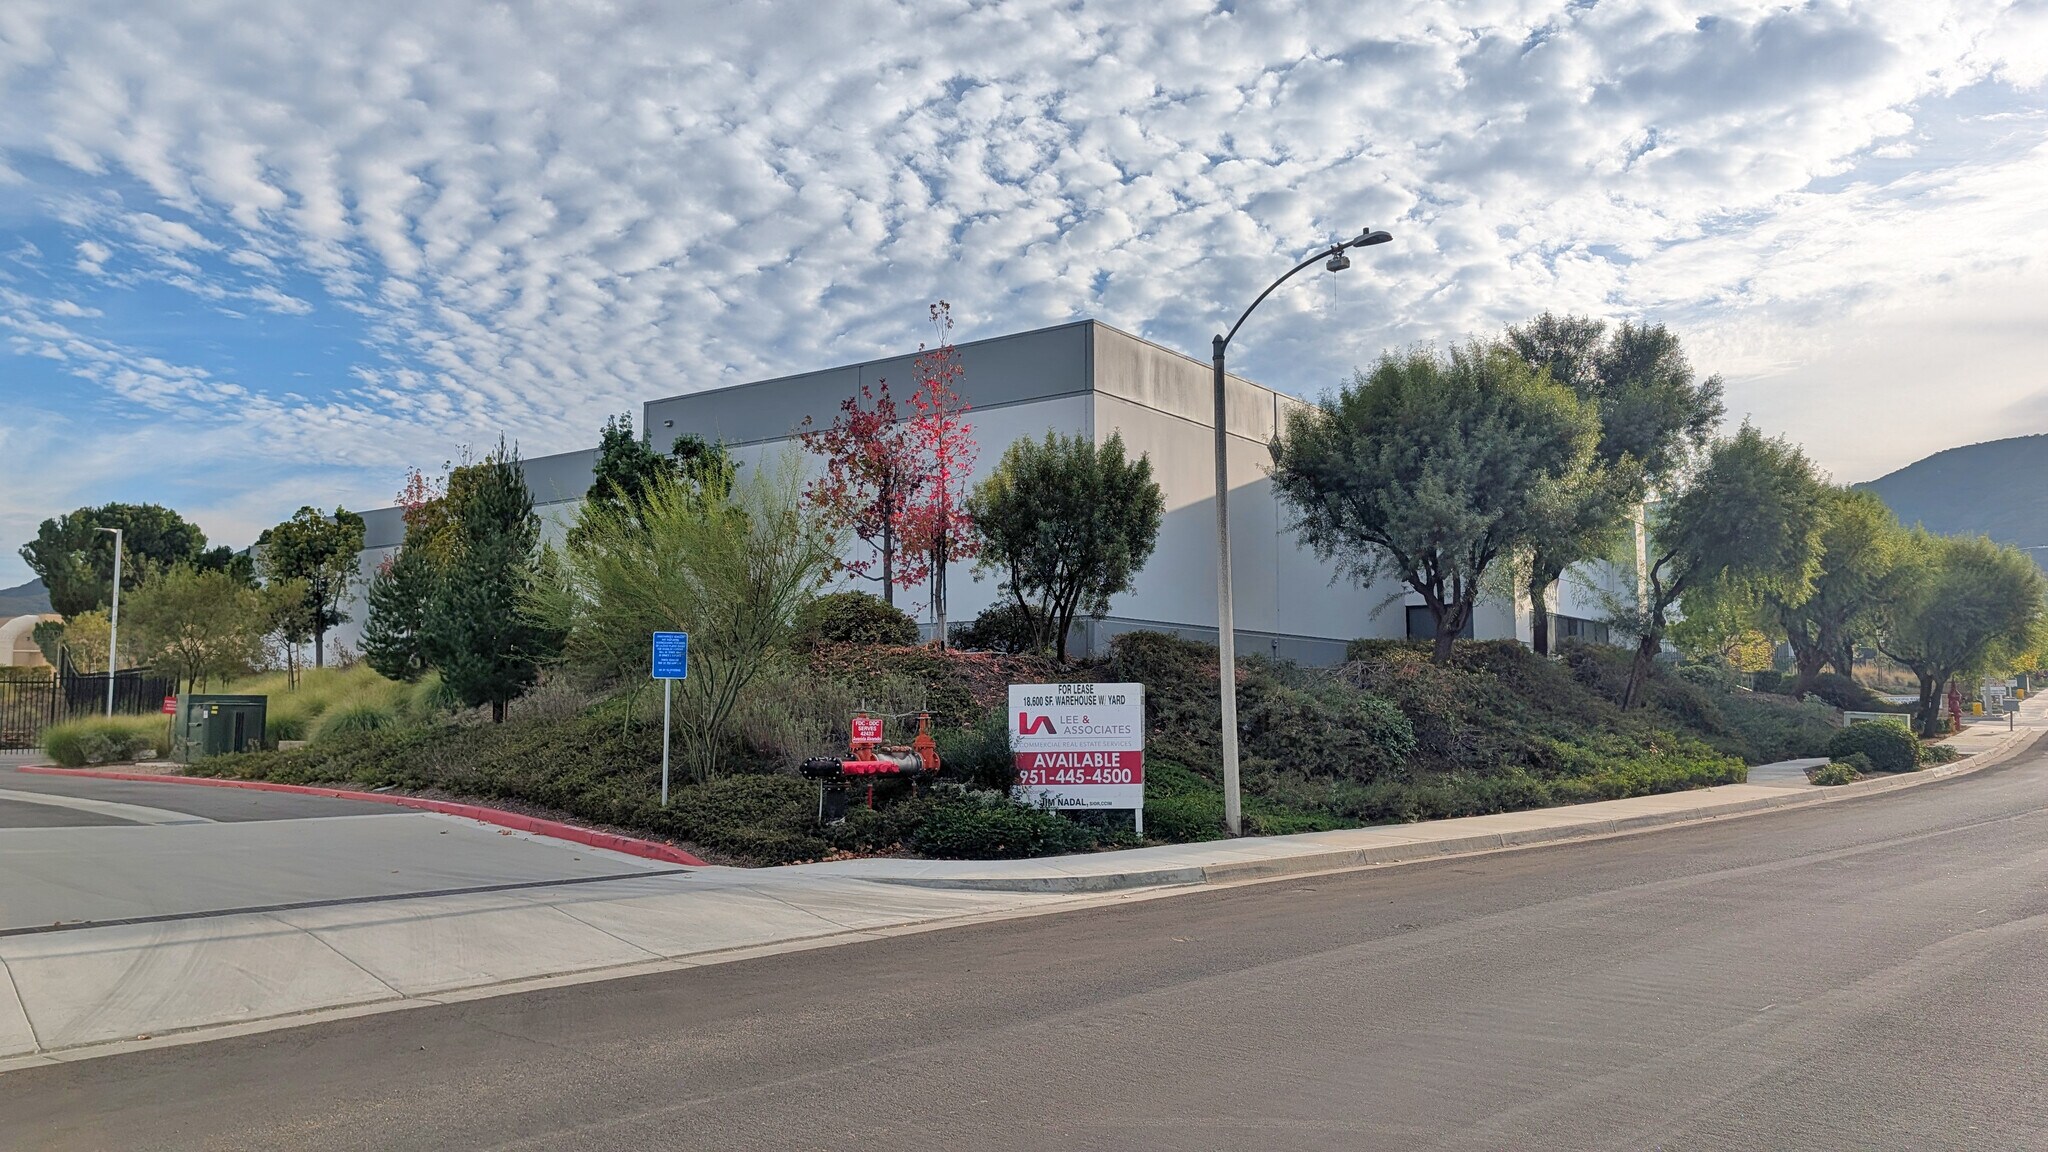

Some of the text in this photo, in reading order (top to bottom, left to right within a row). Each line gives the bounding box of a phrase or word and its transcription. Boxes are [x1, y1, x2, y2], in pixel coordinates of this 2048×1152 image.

[1058, 684, 1093, 694] FOR LEASE
[1056, 696, 1097, 705] WAREHOUSE
[1108, 695, 1125, 705] YARD
[1060, 715, 1089, 724] LEE &
[1064, 725, 1130, 734] ASSOCIATES
[1034, 753, 1120, 767] AVAILABLE
[1019, 769, 1131, 784] 951-445-4500
[1058, 798, 1089, 807] NADAL,
